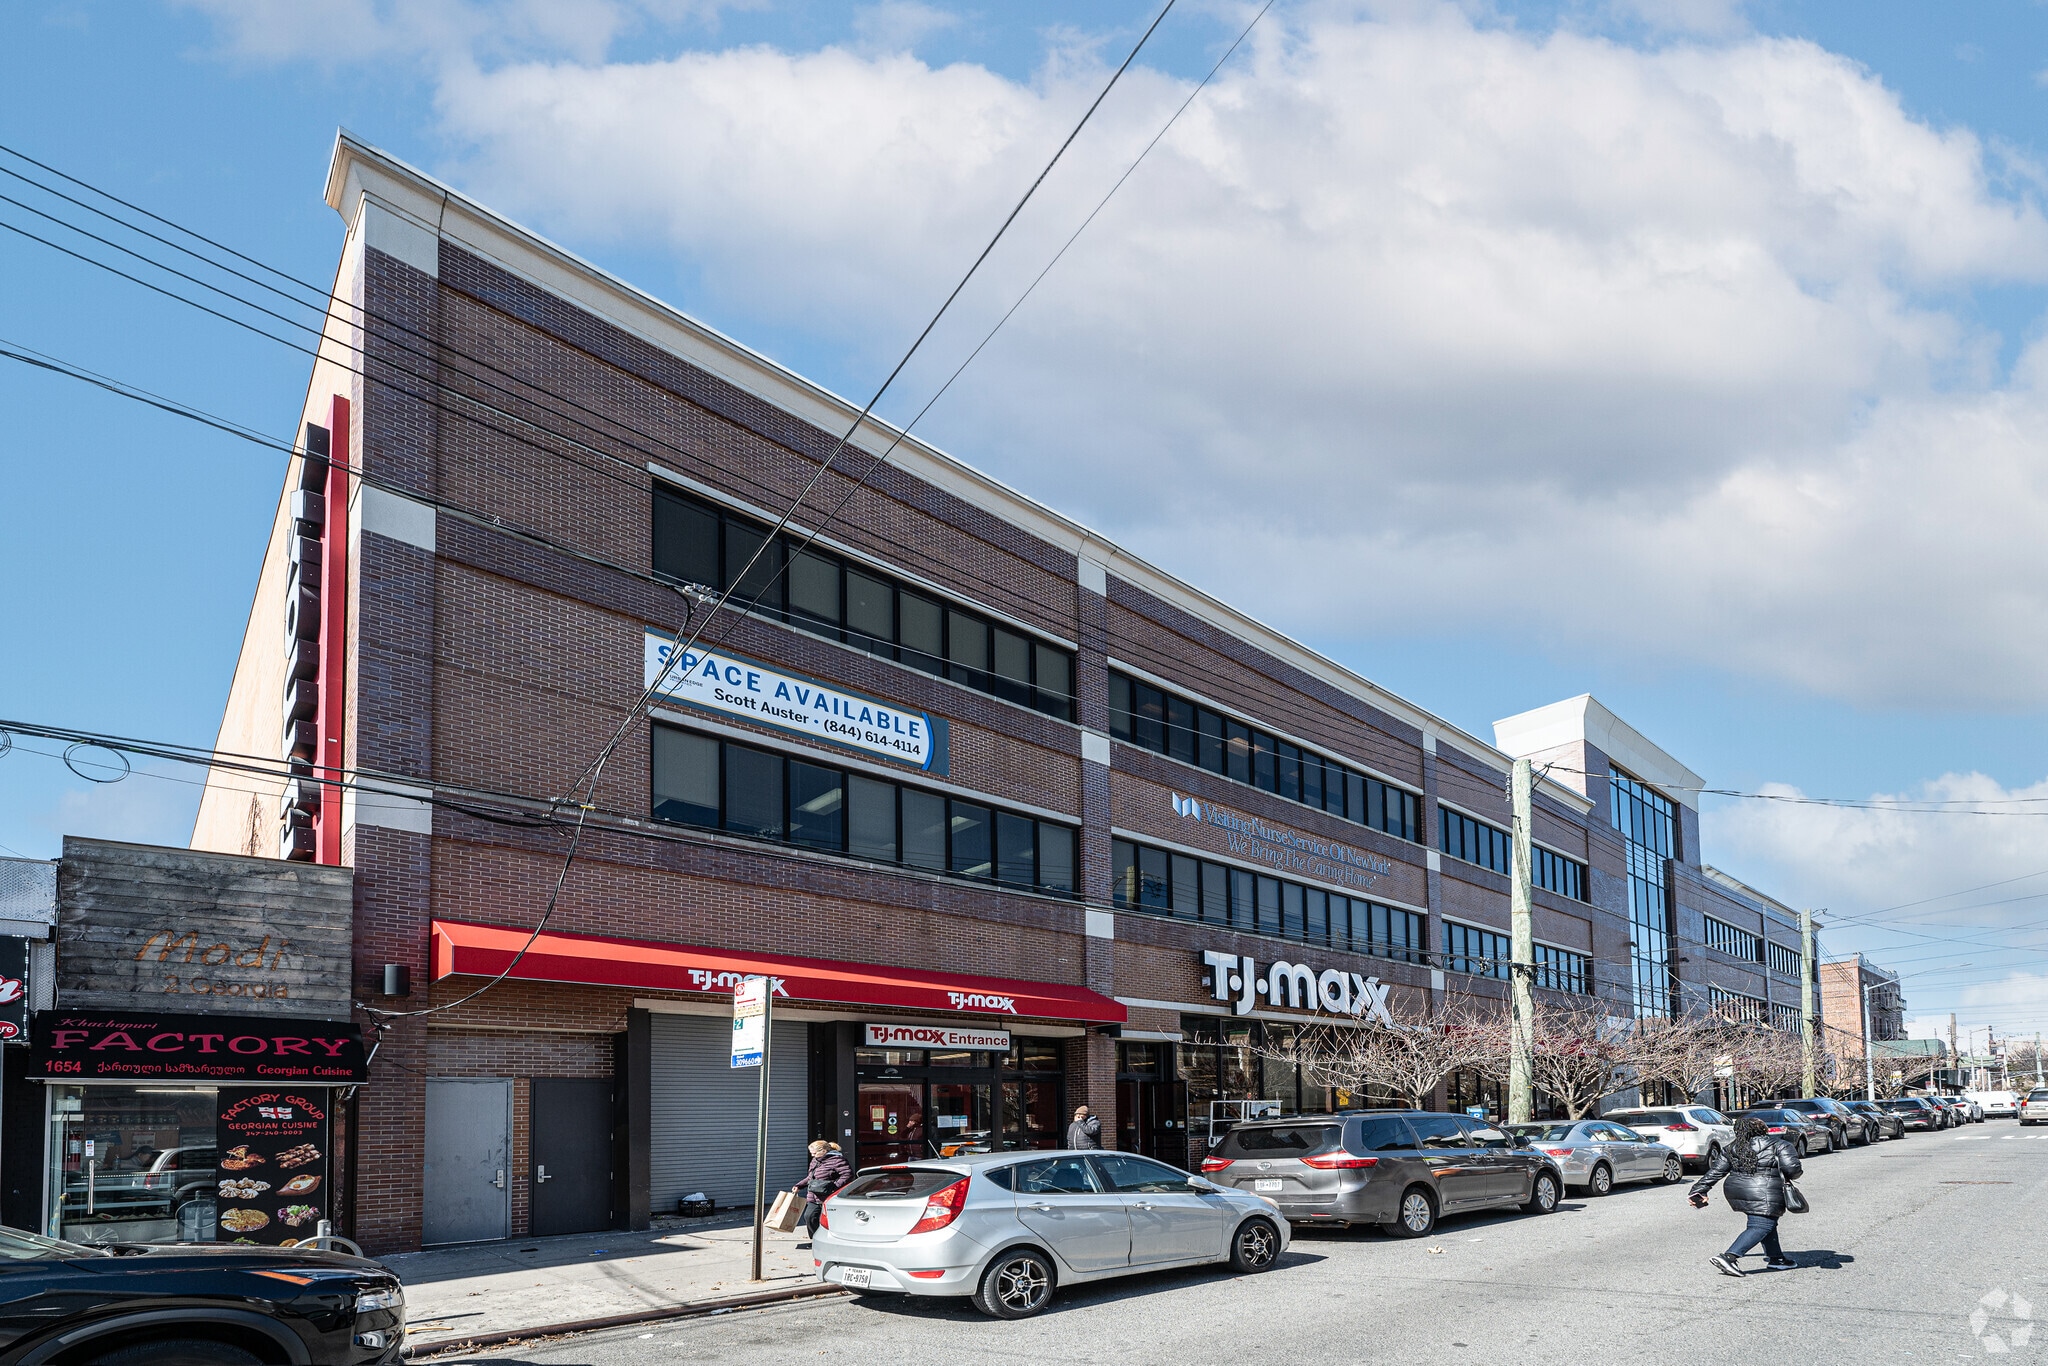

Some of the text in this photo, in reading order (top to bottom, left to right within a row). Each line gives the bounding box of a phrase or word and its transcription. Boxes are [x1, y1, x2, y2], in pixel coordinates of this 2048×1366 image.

[657, 645, 921, 740] SPACE AVAILABLE
[714, 688, 921, 756] Scott Auster (844) 614-4114
[1203, 801, 1390, 875] Visiting Nurse Service Of New York
[1227, 831, 1374, 889] We Bring The Caring Home
[133, 929, 290, 972] Modi
[164, 975, 288, 1001] 2 Georgia
[54, 1018, 158, 1031] Khachapuri
[50, 1030, 350, 1057] FACTORY
[949, 1032, 1008, 1046] Entrance
[45, 1060, 82, 1073] 1654
[97, 1061, 162, 1074] ქართული
[256, 1064, 353, 1077] Georgian Cuisine
[221, 1093, 325, 1121] FACTORY GROUP
[228, 1121, 318, 1131] GEORGIAN CUISINE
